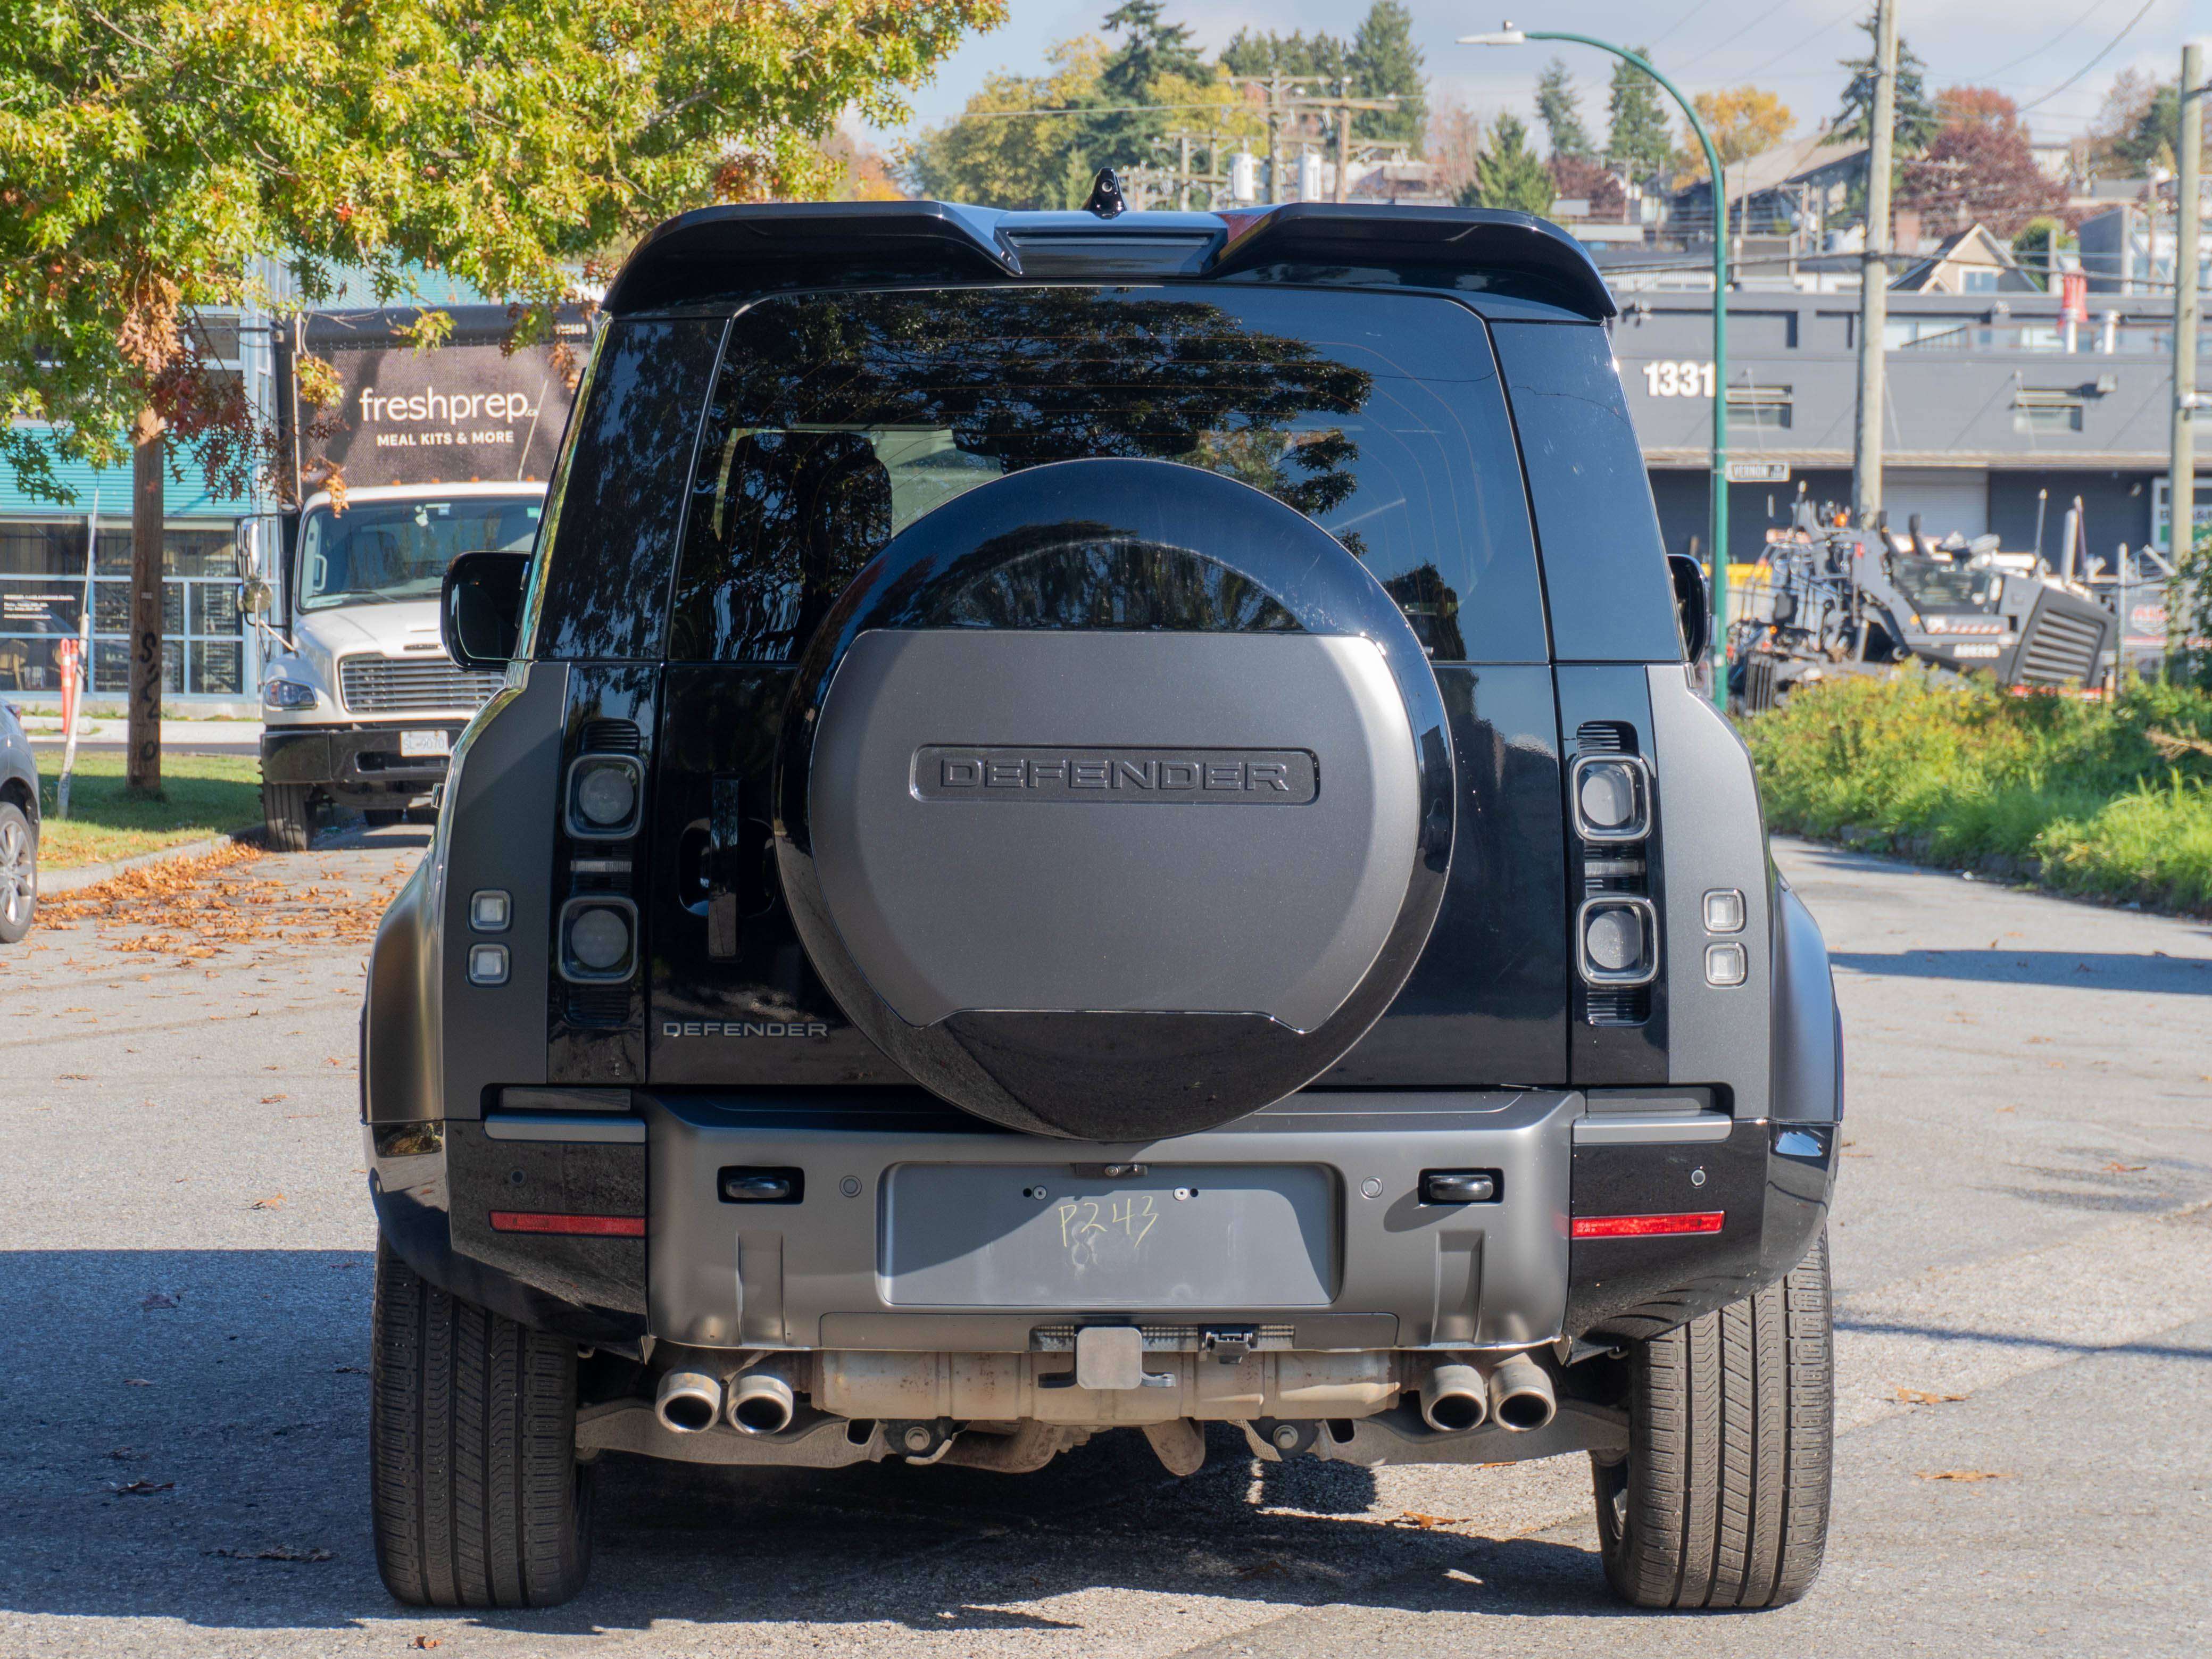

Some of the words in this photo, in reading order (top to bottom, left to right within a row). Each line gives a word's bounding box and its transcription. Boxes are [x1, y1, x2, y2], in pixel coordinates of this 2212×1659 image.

[1643, 362, 1716, 397] 1331
[377, 433, 417, 447] MEAL
[420, 432, 452, 446] KITS
[456, 432, 467, 445] &
[471, 430, 514, 444] MORE
[941, 758, 1288, 791] DEFENDER
[663, 1022, 827, 1037] DEFENDER
[1059, 1196, 1159, 1247] P243
